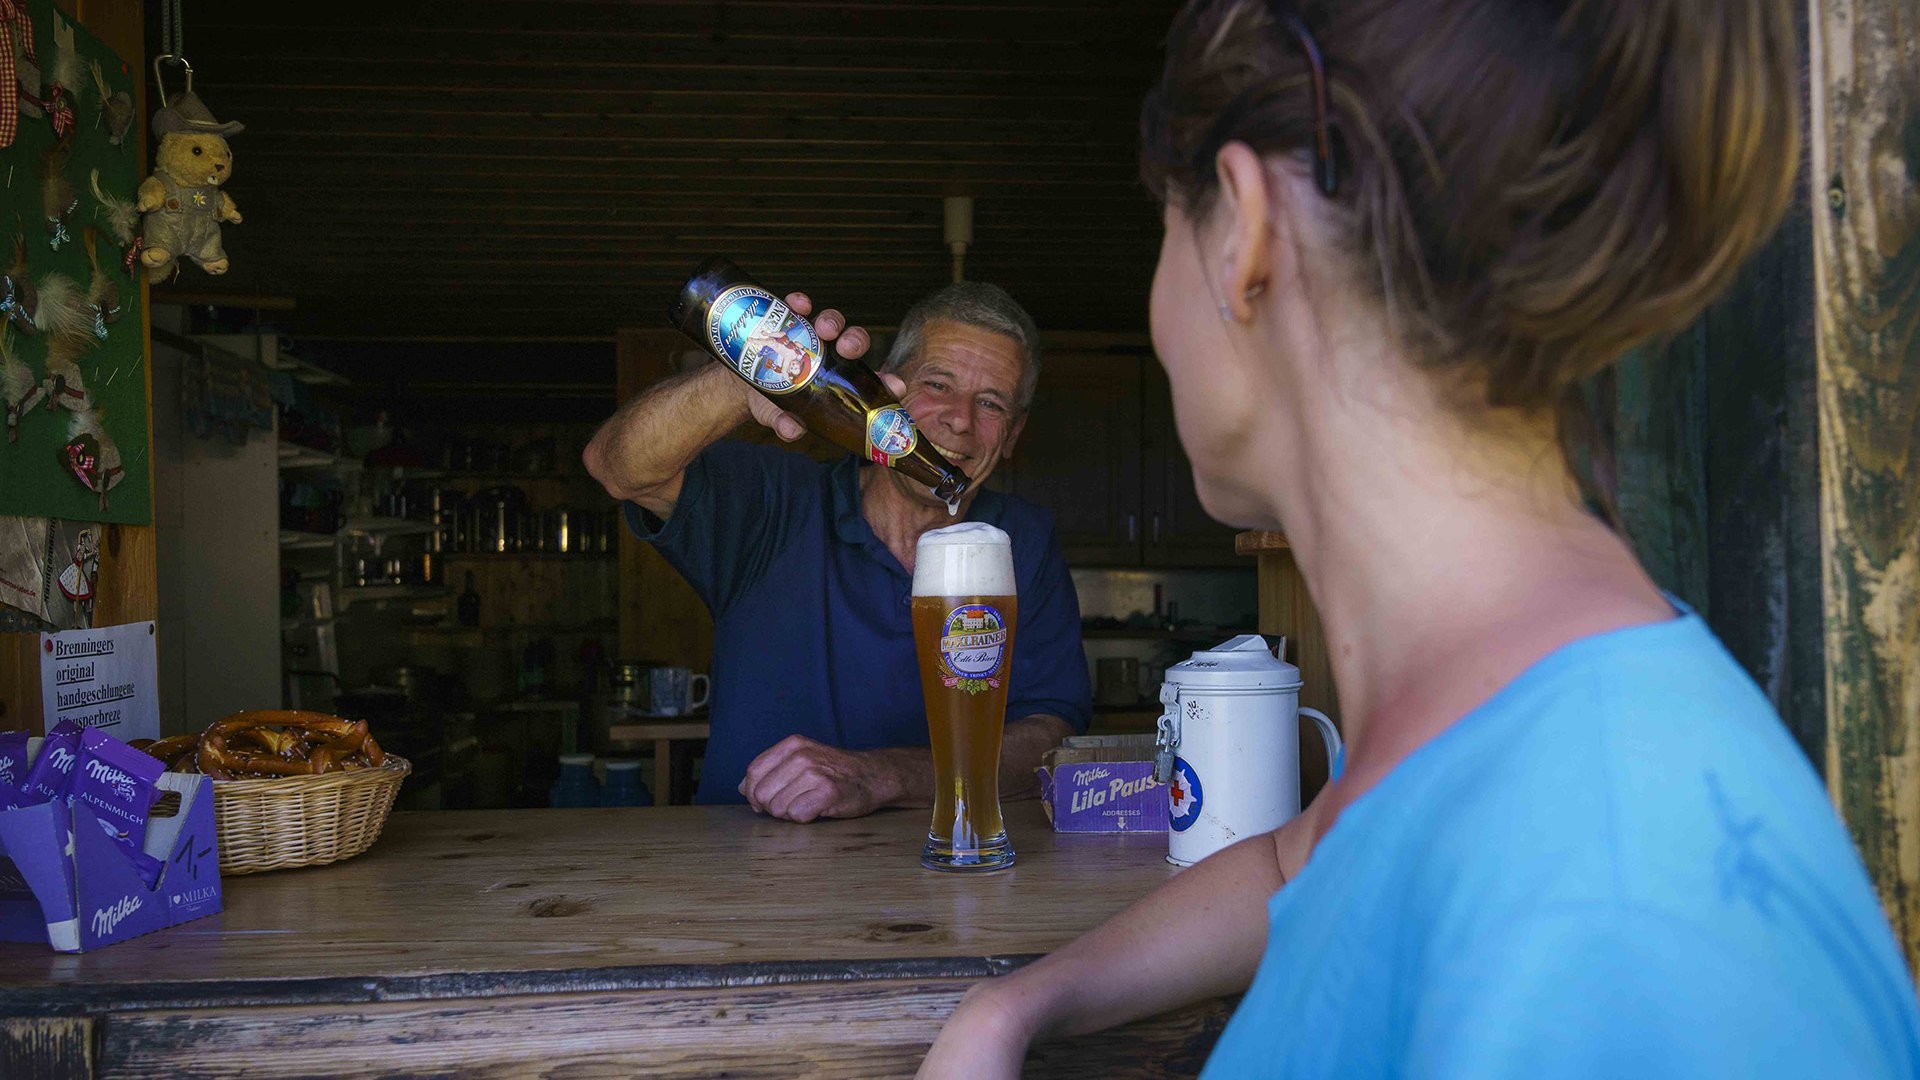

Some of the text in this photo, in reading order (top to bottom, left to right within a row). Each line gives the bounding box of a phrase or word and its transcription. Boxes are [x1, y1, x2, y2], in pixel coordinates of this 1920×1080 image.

[725, 299, 760, 348] alkoholfrei
[55, 637, 115, 657] Brenningers
[943, 632, 1006, 650] MAXLRAINER
[953, 652, 972, 663] Edle
[55, 661, 95, 682] original
[56, 681, 135, 707] handgeschlungene
[85, 759, 137, 785] Milka
[1072, 766, 1111, 787] Milka
[81, 791, 144, 825] ALPENMILCH
[1071, 787, 1106, 814] Lila
[182, 886, 217, 904] MILKA
[91, 895, 143, 938] Milka
